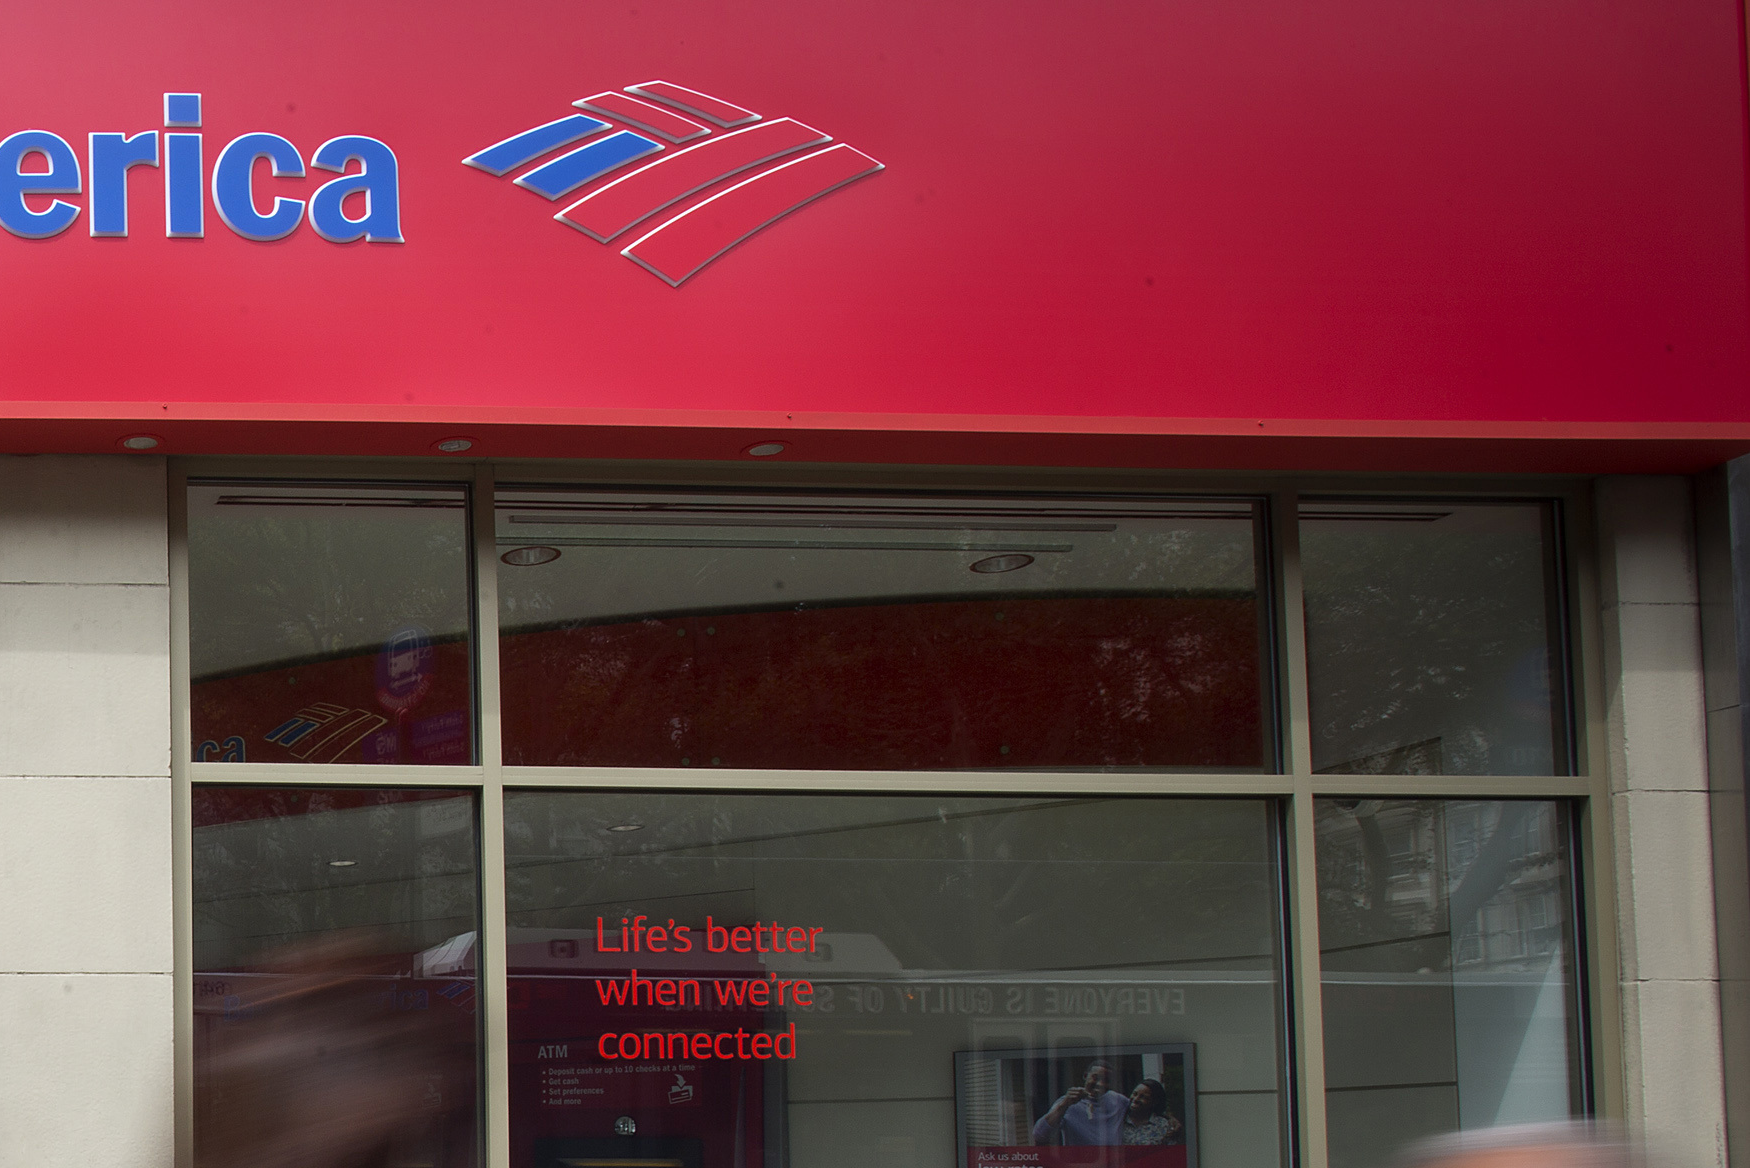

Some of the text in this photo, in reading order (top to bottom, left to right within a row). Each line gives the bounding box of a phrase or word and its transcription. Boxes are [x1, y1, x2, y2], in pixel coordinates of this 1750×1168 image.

[597, 916, 823, 953] Life's better
[596, 969, 813, 1006] when we're
[598, 1022, 796, 1060] connected
[538, 1045, 568, 1059] ATM
[548, 1068, 575, 1077] Deposit
[576, 1067, 593, 1075] cash
[624, 1065, 633, 1073] 10
[635, 1065, 661, 1073] checks
[679, 1064, 696, 1072] time
[562, 1077, 579, 1085] cash
[549, 1087, 604, 1097] Set preferences
[548, 1097, 562, 1105] And
[978, 1152, 1039, 1161] Ask us about
